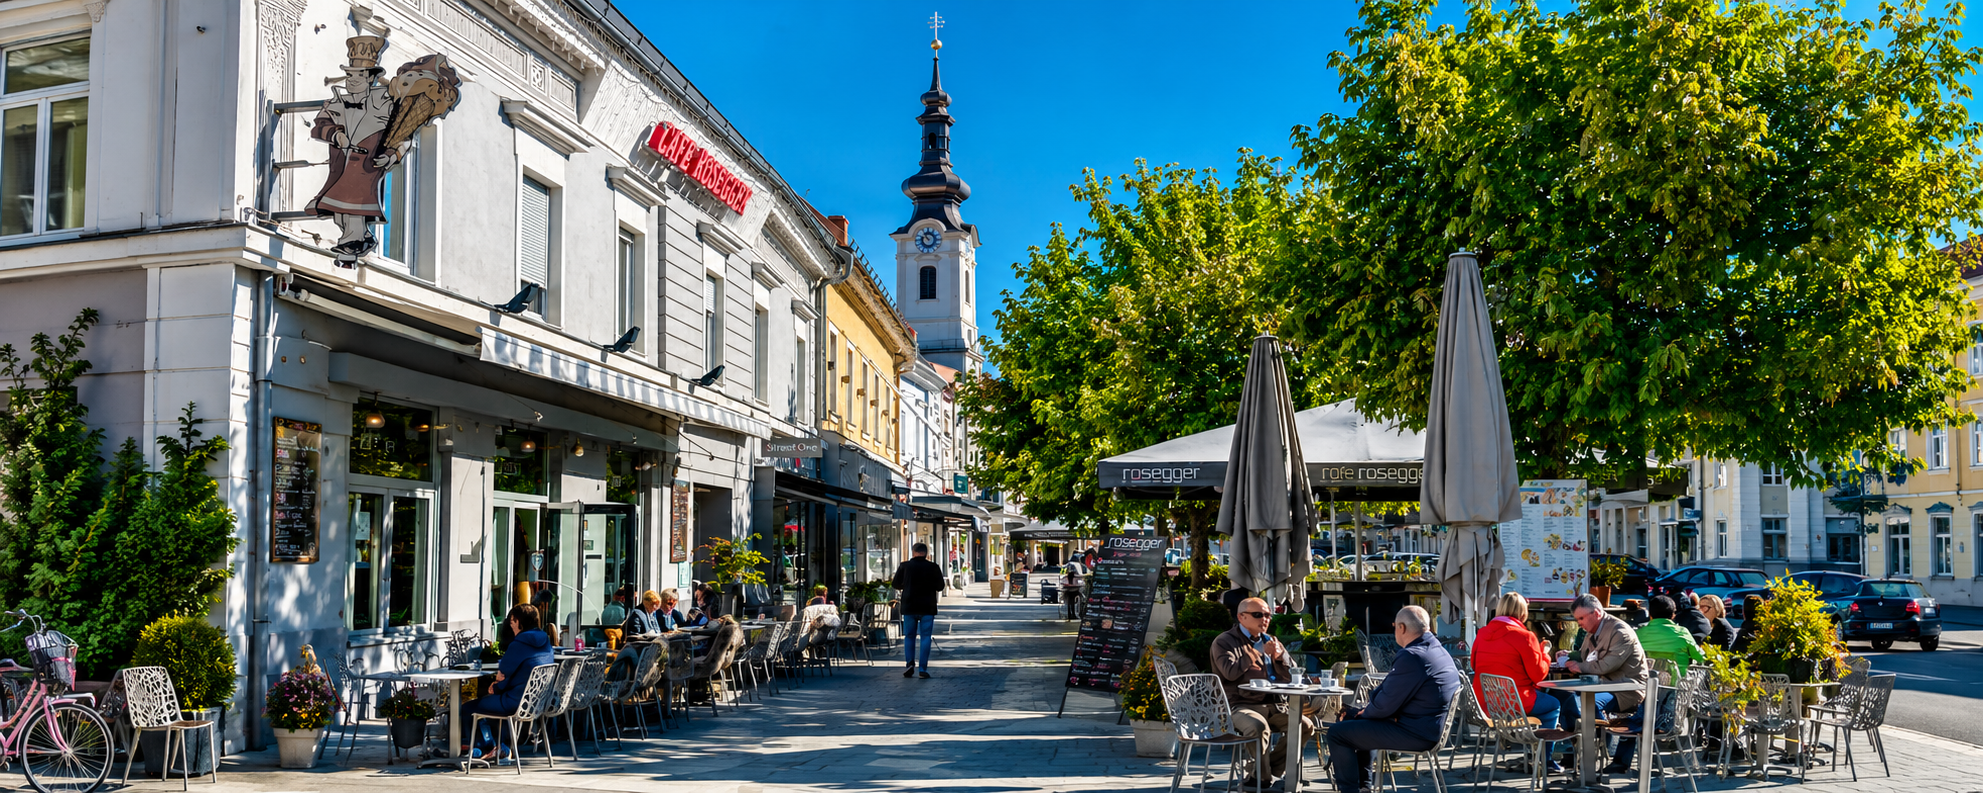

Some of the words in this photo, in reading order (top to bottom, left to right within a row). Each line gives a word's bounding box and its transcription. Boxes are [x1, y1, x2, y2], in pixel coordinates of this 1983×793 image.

[766, 443, 796, 452] Street
[797, 443, 818, 452] One
[1122, 467, 1200, 484] rosegger
[1104, 537, 1163, 551] rosegger
